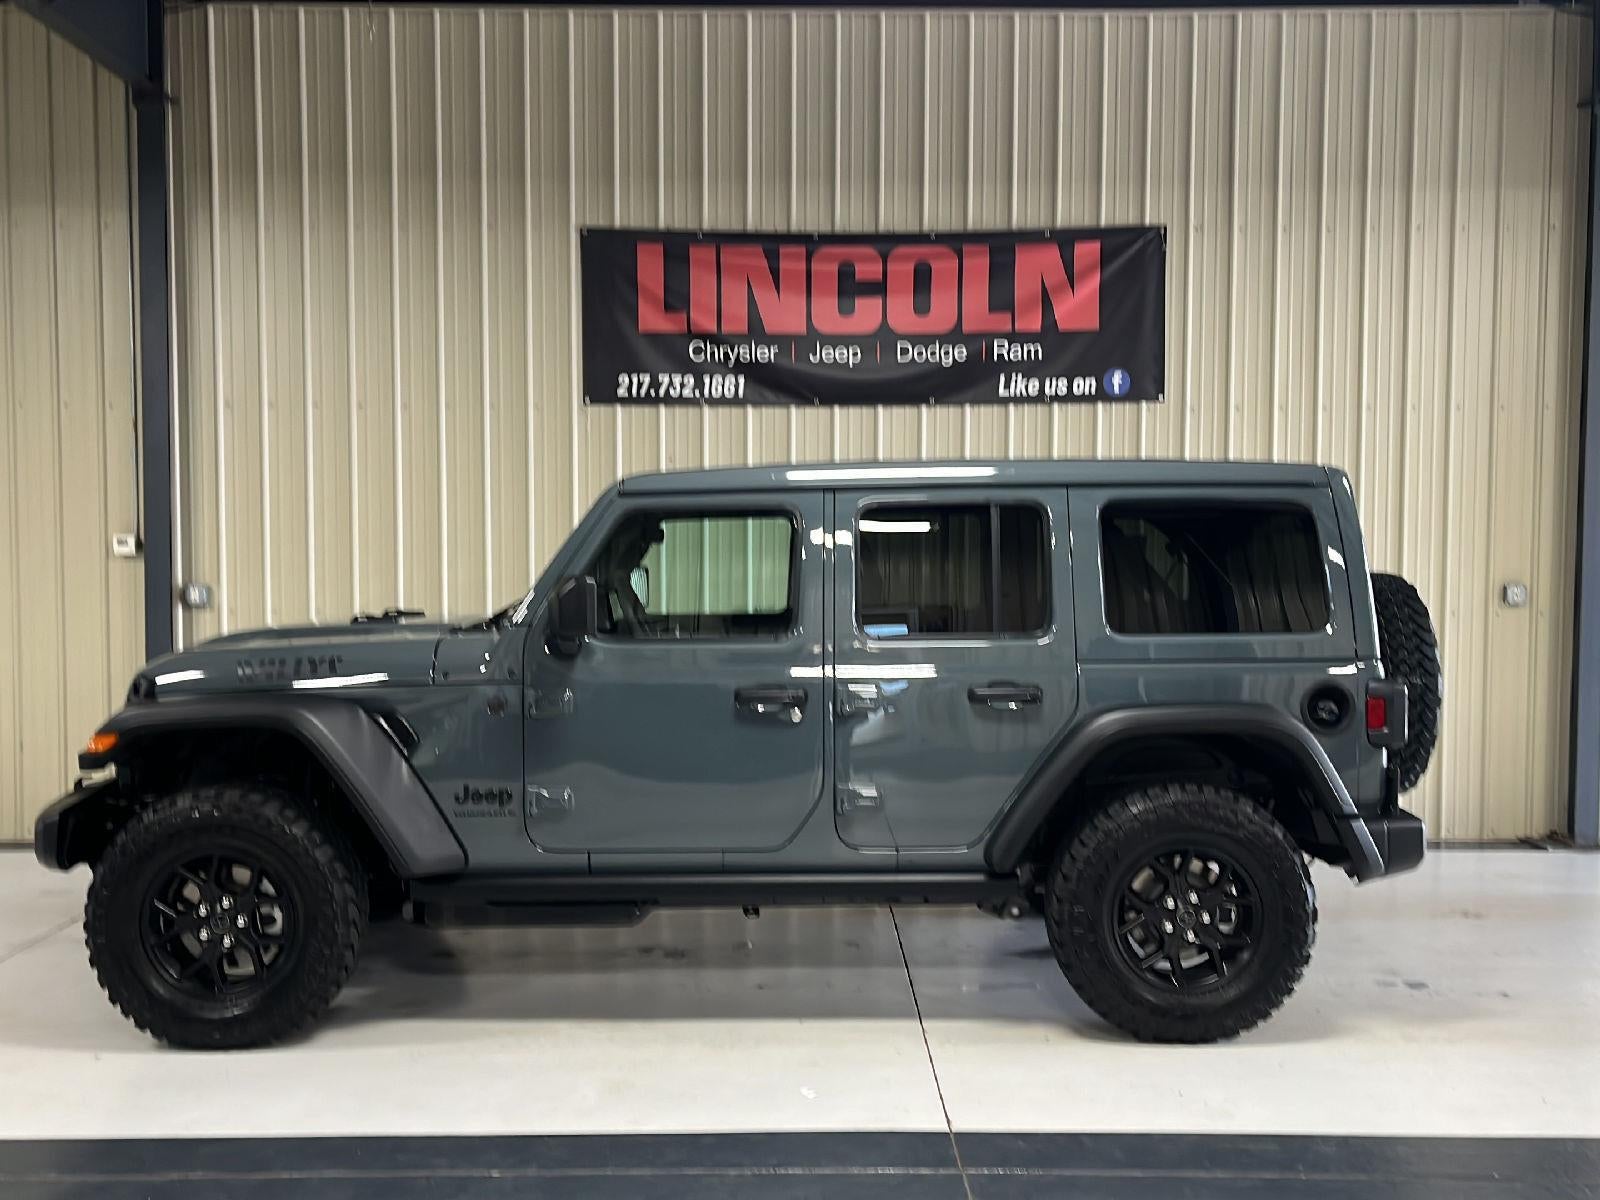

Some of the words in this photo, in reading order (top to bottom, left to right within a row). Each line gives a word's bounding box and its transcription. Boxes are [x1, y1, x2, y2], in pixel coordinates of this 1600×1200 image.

[636, 239, 1102, 336] LINCOLN
[688, 338, 779, 368] Chrysler
[809, 339, 862, 368] Jeep
[897, 339, 967, 368] Dodge
[993, 338, 1043, 362] Ram
[999, 371, 1040, 398] Like
[1044, 376, 1068, 396] us
[1072, 376, 1097, 396] on
[454, 783, 513, 807] Jeep
